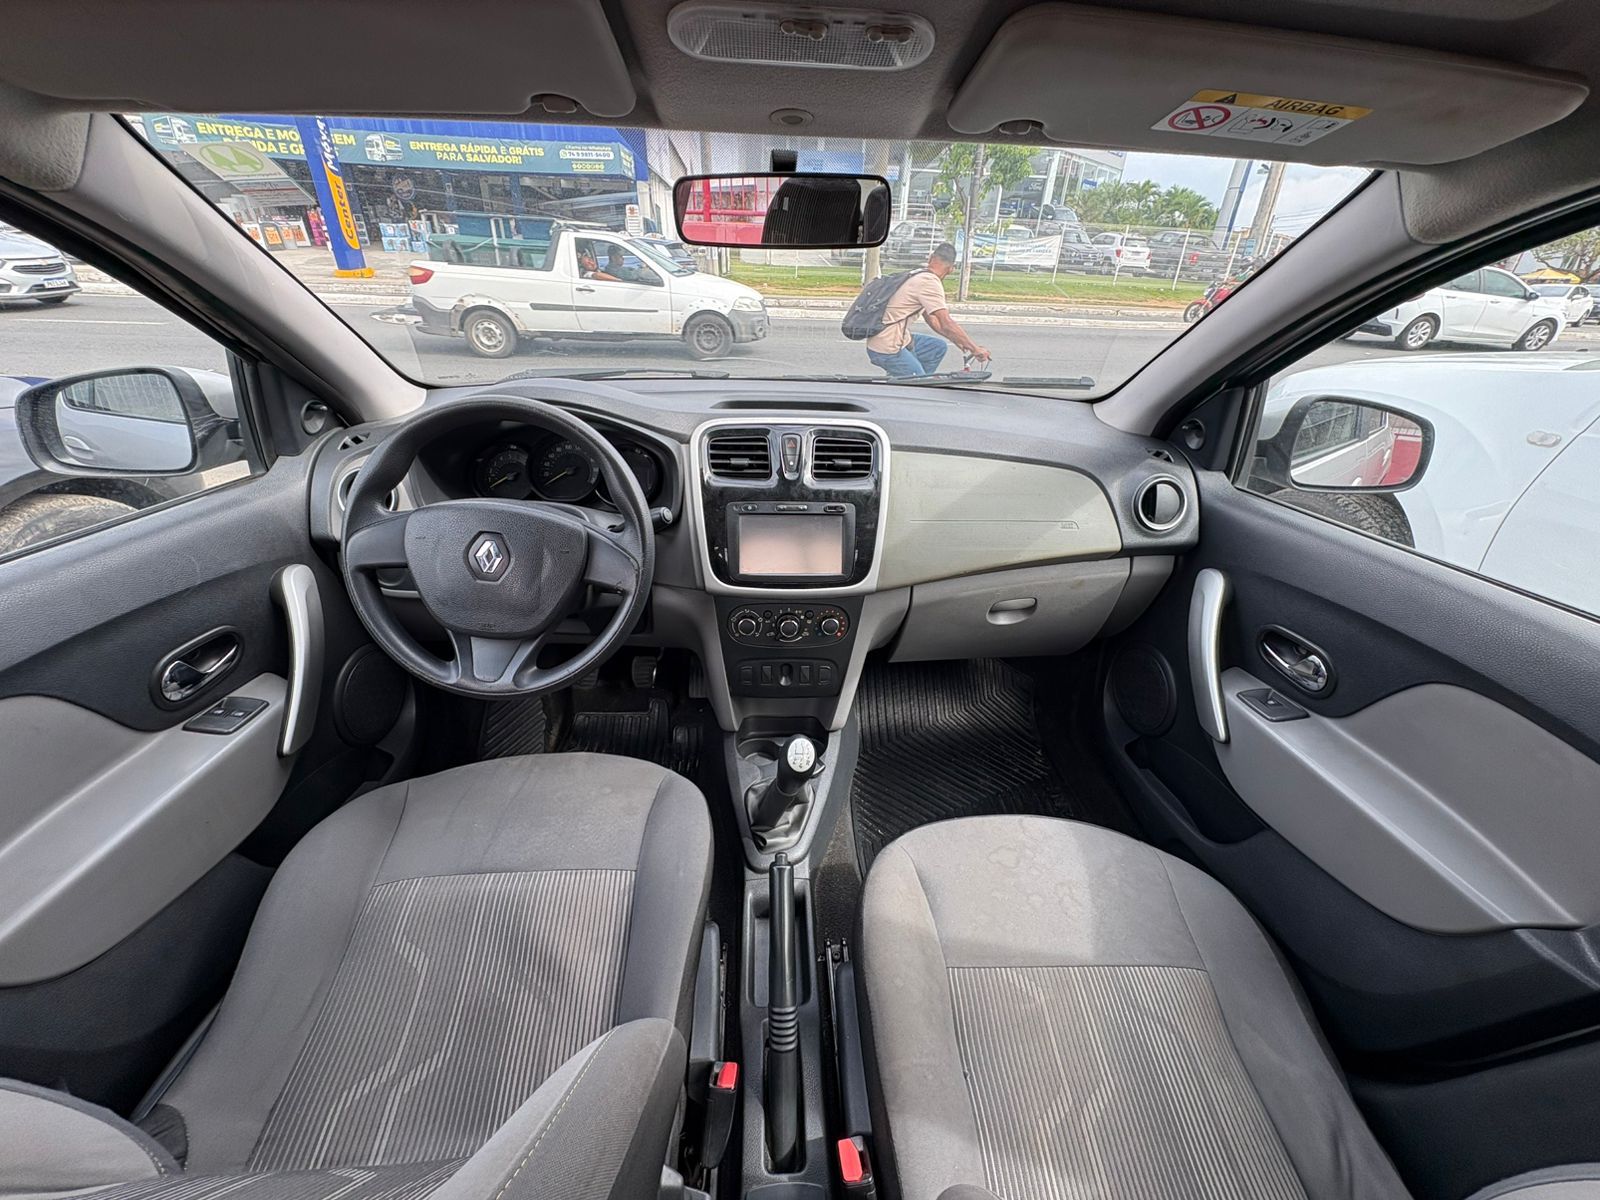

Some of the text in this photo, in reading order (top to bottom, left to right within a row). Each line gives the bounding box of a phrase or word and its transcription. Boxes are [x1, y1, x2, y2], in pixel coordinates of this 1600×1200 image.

[1267, 99, 1346, 116] AIRBAG
[196, 121, 265, 139] ENTREGA
[265, 128, 276, 140] E
[278, 142, 289, 154] E
[409, 141, 545, 157] ENTREGA RÁPIDA E GRÁTIS
[436, 151, 523, 165] PARA SALVADOR!
[334, 180, 354, 240] Center
